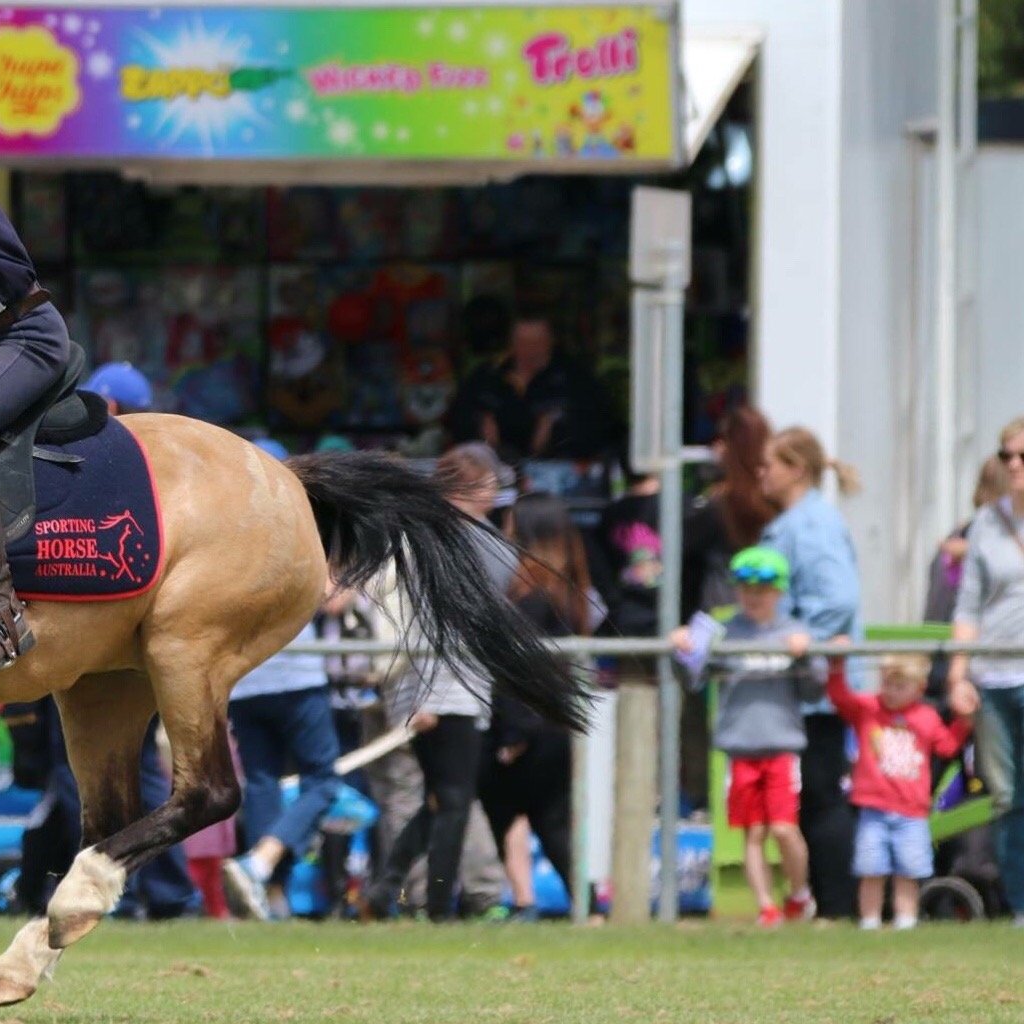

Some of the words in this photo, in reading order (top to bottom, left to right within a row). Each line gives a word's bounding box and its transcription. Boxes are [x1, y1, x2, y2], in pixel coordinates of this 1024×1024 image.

[522, 29, 640, 84] Trolli
[34, 518, 96, 535] SPORTING
[36, 538, 98, 560] HORSE
[34, 563, 97, 577] AUSTRALIA
